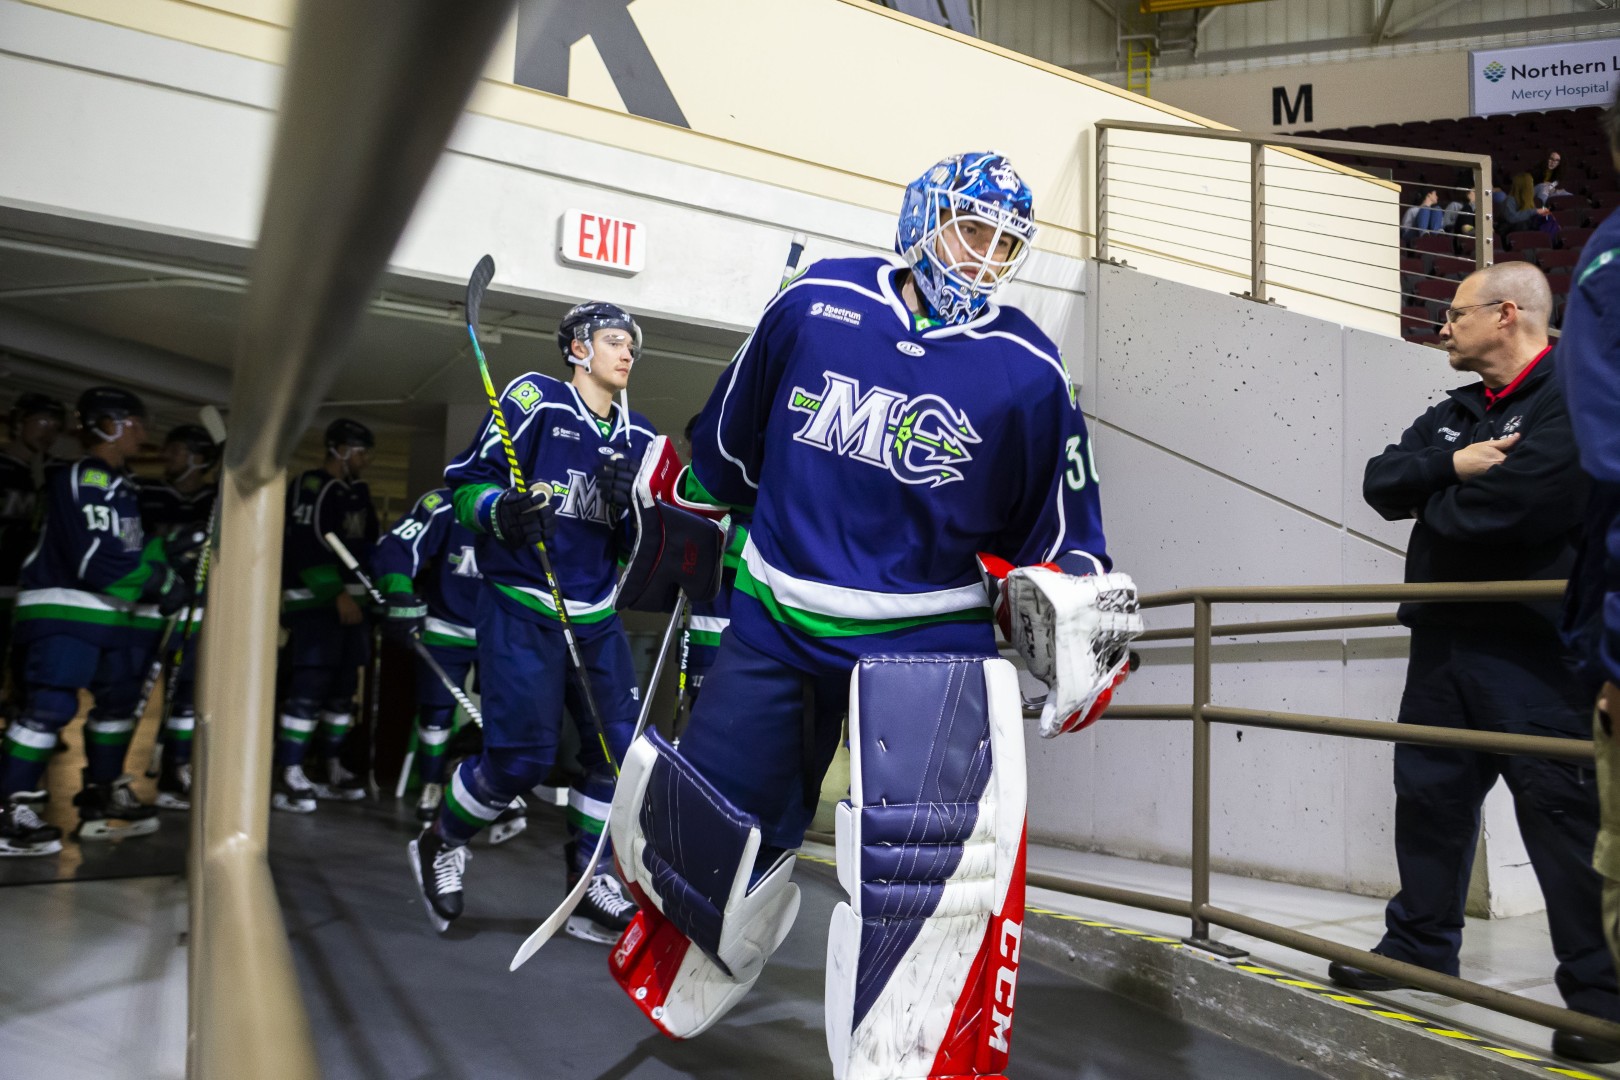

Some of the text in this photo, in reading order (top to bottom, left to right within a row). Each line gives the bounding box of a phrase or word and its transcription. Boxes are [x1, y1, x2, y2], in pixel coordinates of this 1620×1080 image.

[1511, 60, 1606, 81] Northern
[1272, 83, 1314, 126] M
[1511, 80, 1609, 101] Mercy Hospital
[577, 212, 636, 266] EXIT
[824, 304, 861, 321] Spectrum
[82, 503, 110, 532] 13
[391, 518, 423, 540] 16
[680, 630, 691, 671] ALPHA
[988, 917, 1023, 1054] CCM
